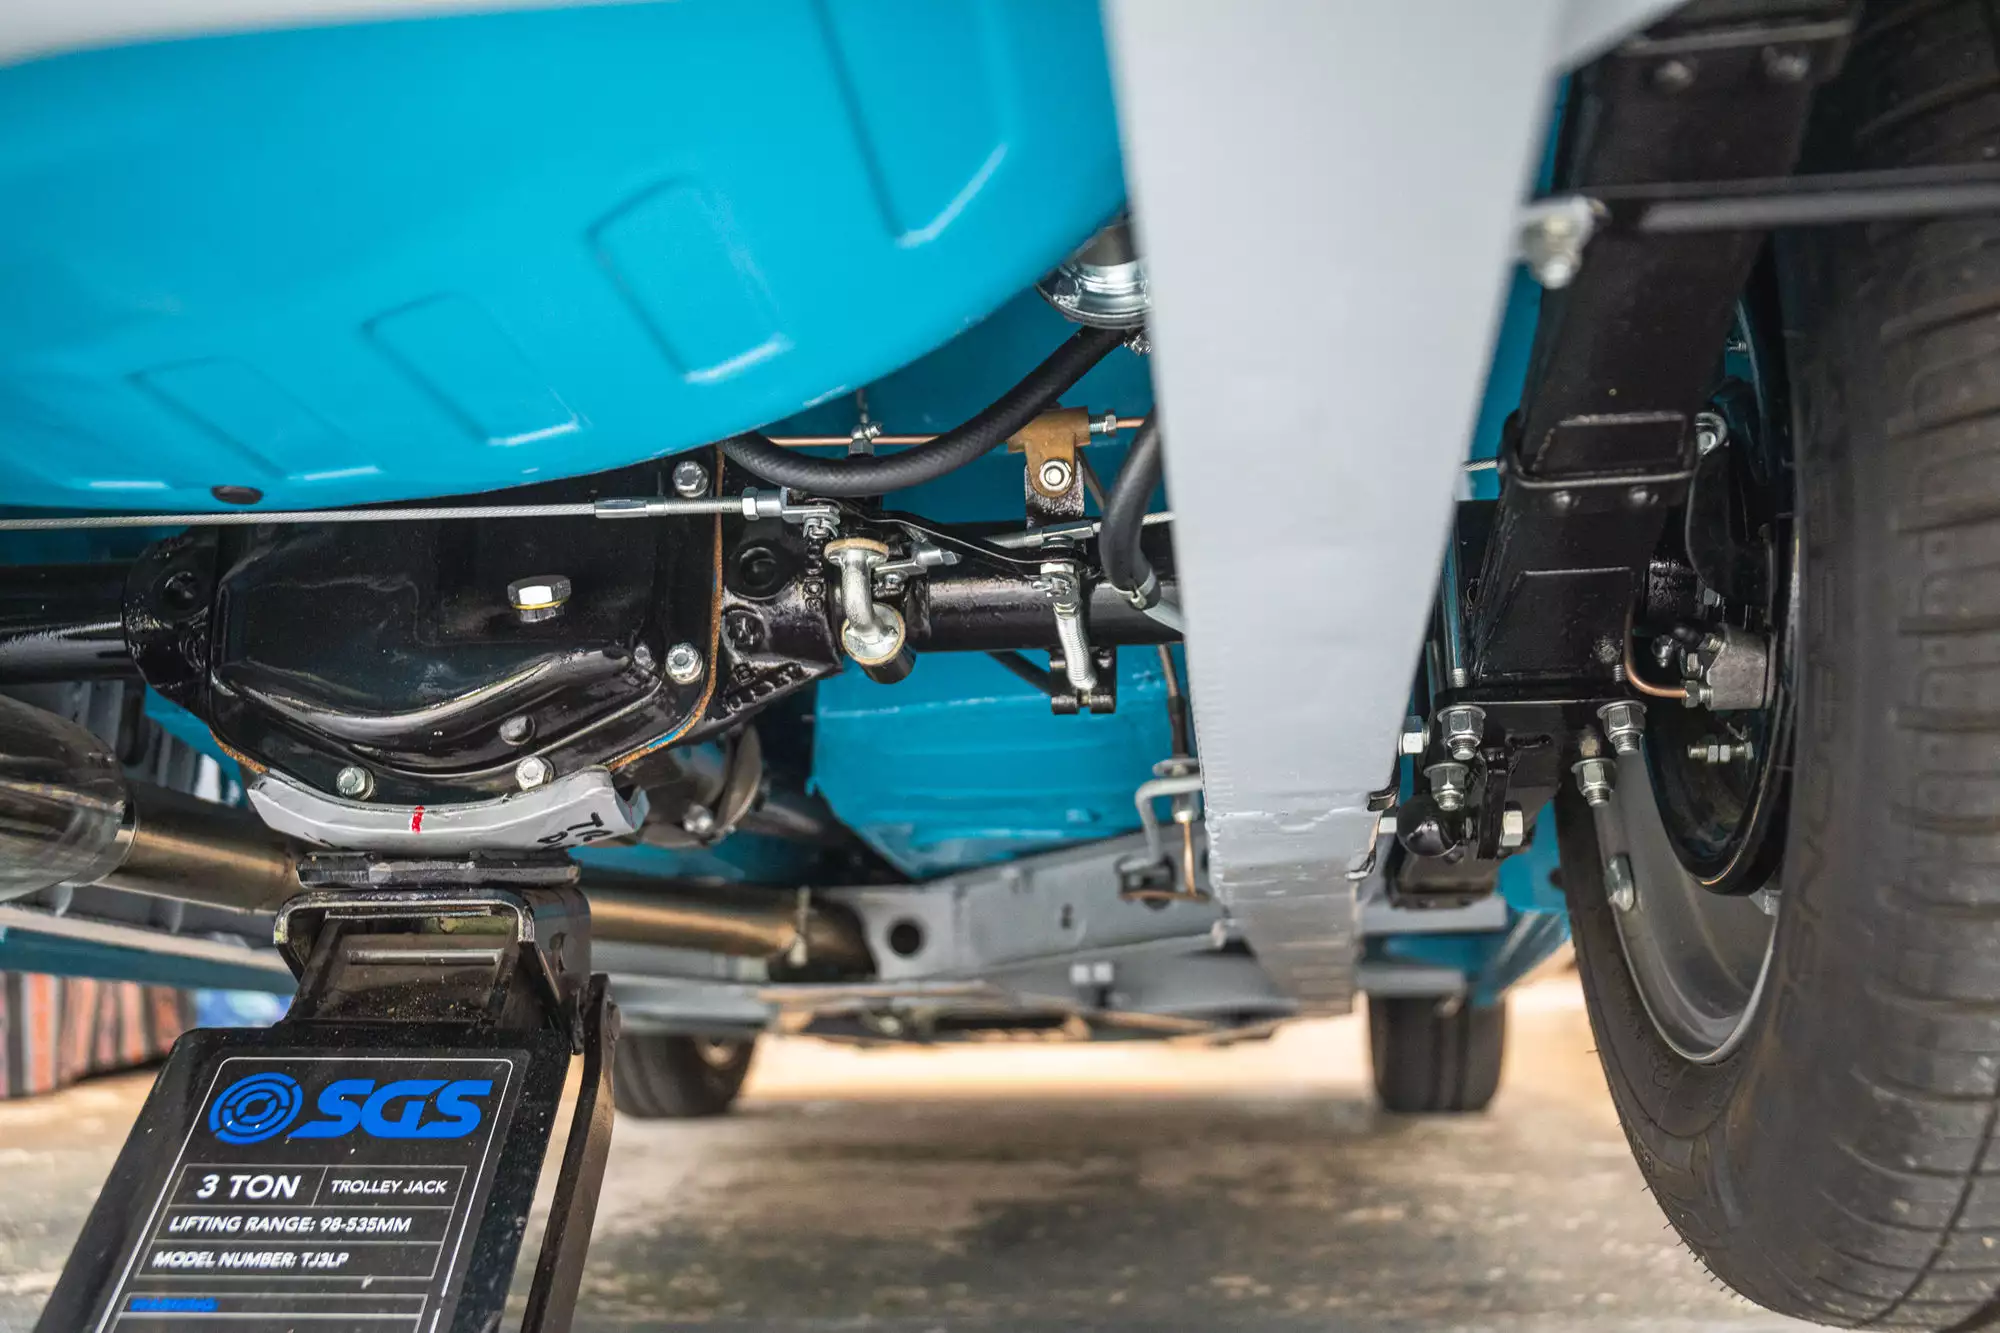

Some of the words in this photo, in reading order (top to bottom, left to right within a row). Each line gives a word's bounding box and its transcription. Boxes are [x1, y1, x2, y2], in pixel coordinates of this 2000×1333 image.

[286, 1079, 493, 1139] SGS
[196, 1174, 220, 1199] 3
[229, 1174, 302, 1199] TON
[331, 1179, 402, 1195] TROLLEY
[402, 1179, 449, 1195] JACK
[168, 1215, 243, 1233] LIFTING
[244, 1215, 317, 1233] RANGE:
[319, 1216, 413, 1233] 98-535MM
[151, 1250, 217, 1269] MODEL
[217, 1250, 298, 1269] NUMBER:
[301, 1251, 350, 1269] TJ3LP
